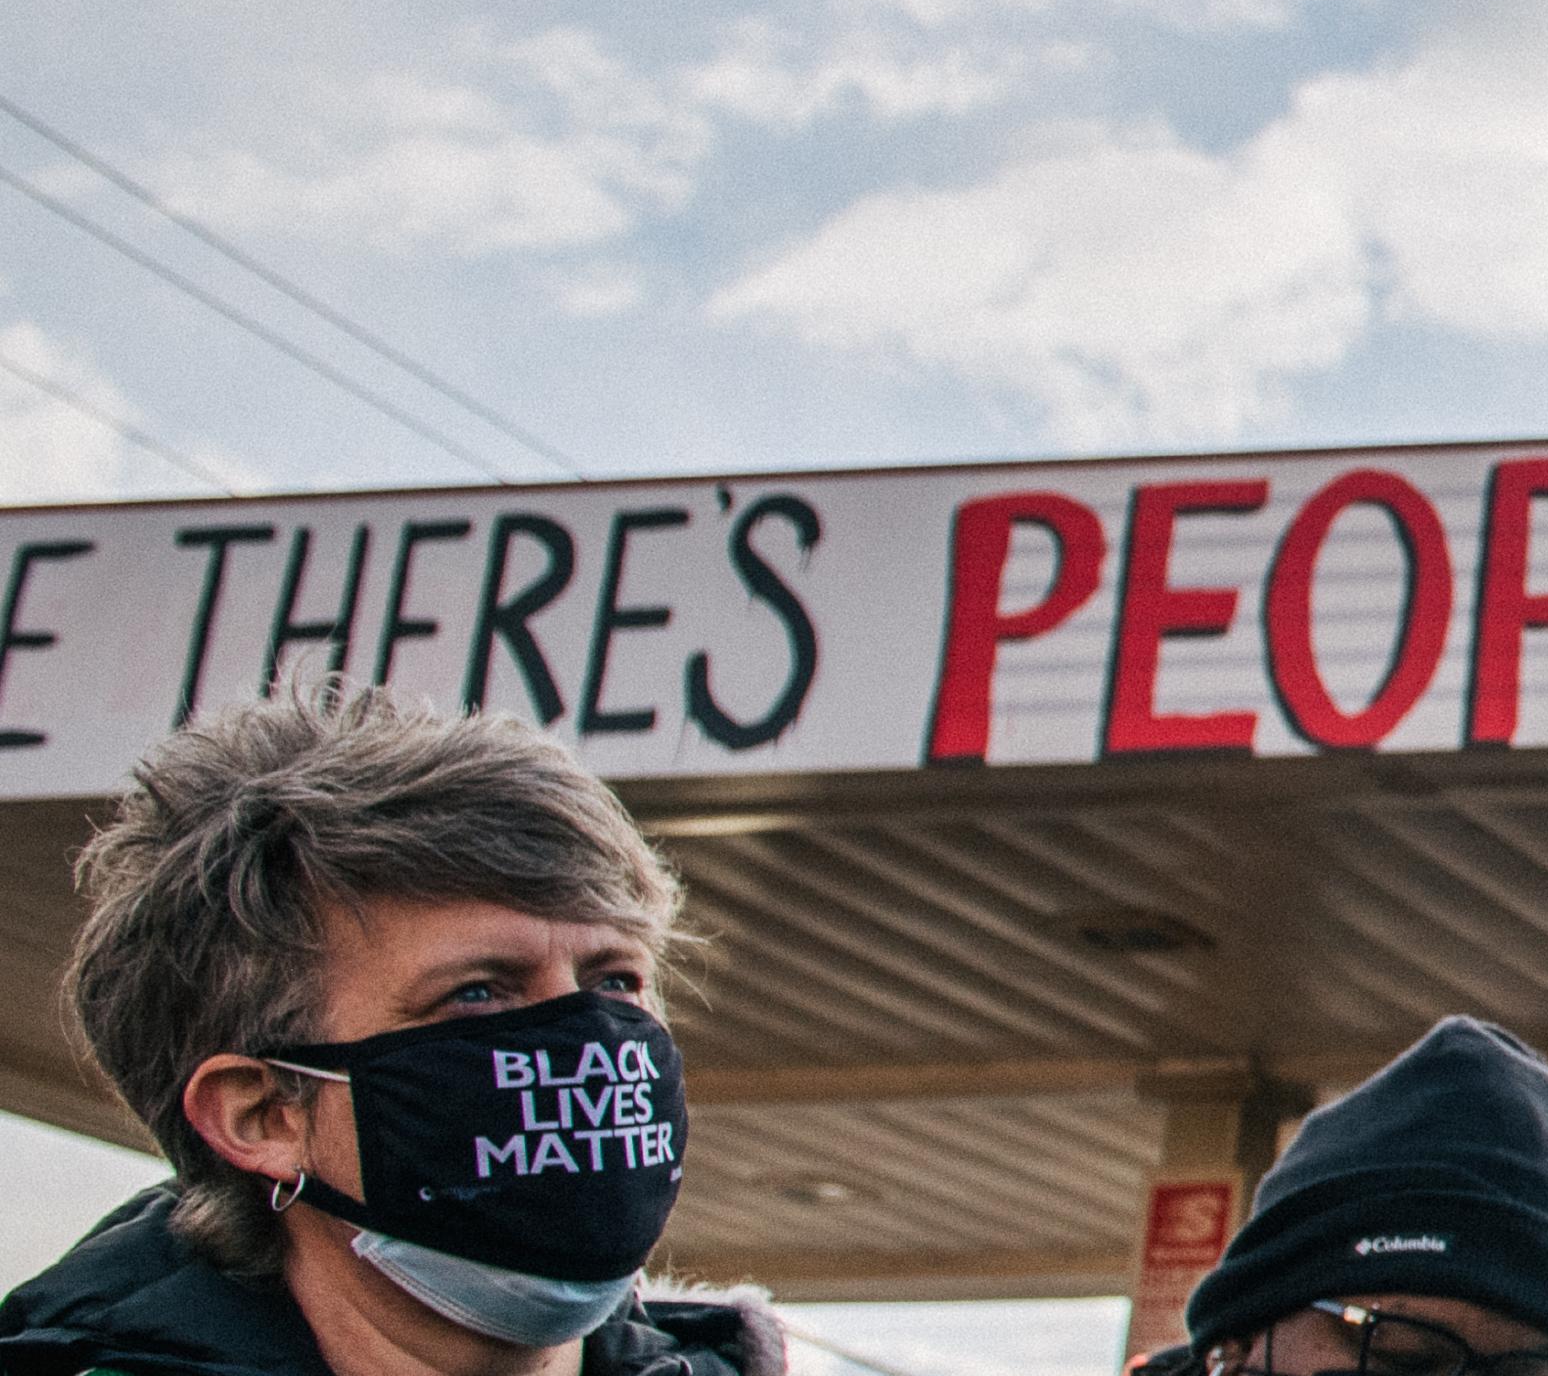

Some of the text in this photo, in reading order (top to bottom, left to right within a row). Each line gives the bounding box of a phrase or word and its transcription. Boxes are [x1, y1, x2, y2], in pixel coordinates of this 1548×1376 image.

[172, 482, 822, 751] THERE'S
[491, 1040, 661, 1089] BLACK
[520, 1082, 653, 1132] LIVES
[474, 1122, 675, 1179] MATTER
[1372, 1235, 1446, 1253] Columbia
